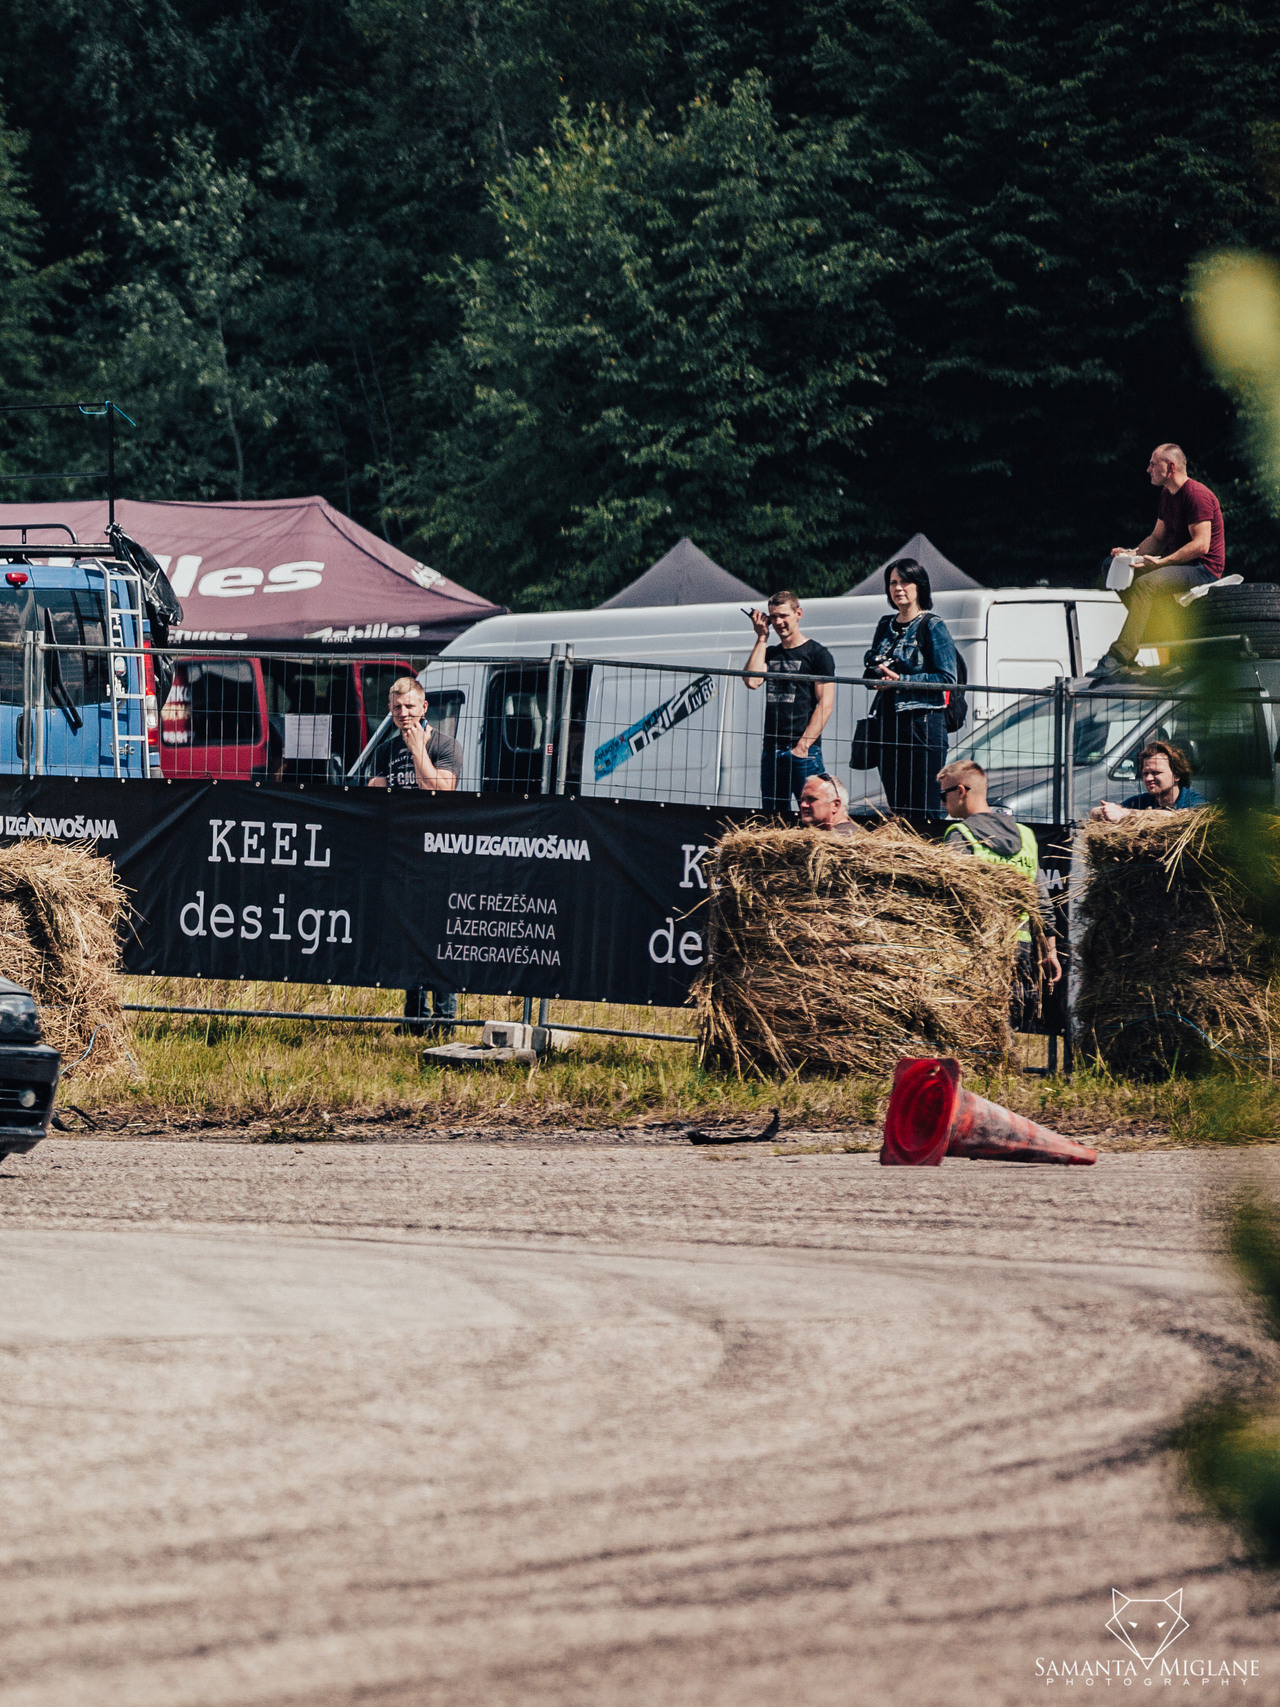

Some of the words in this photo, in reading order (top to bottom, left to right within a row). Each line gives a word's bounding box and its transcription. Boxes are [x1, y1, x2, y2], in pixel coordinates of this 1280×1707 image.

[155, 554, 325, 598] lles
[303, 622, 420, 640] Achilles
[5, 814, 119, 840] IZGATAVOŠANA
[207, 819, 331, 867] KEEL
[424, 832, 474, 855] BALVU
[475, 834, 592, 862] IZGATAVOŠANA
[448, 893, 477, 911] CNC
[479, 893, 558, 915] FRĒZĒŠANA
[179, 890, 353, 955] design
[446, 916, 556, 940] LĀZERGRIEŠANA
[437, 942, 561, 966] LĀZERGRAVĒŠANA
